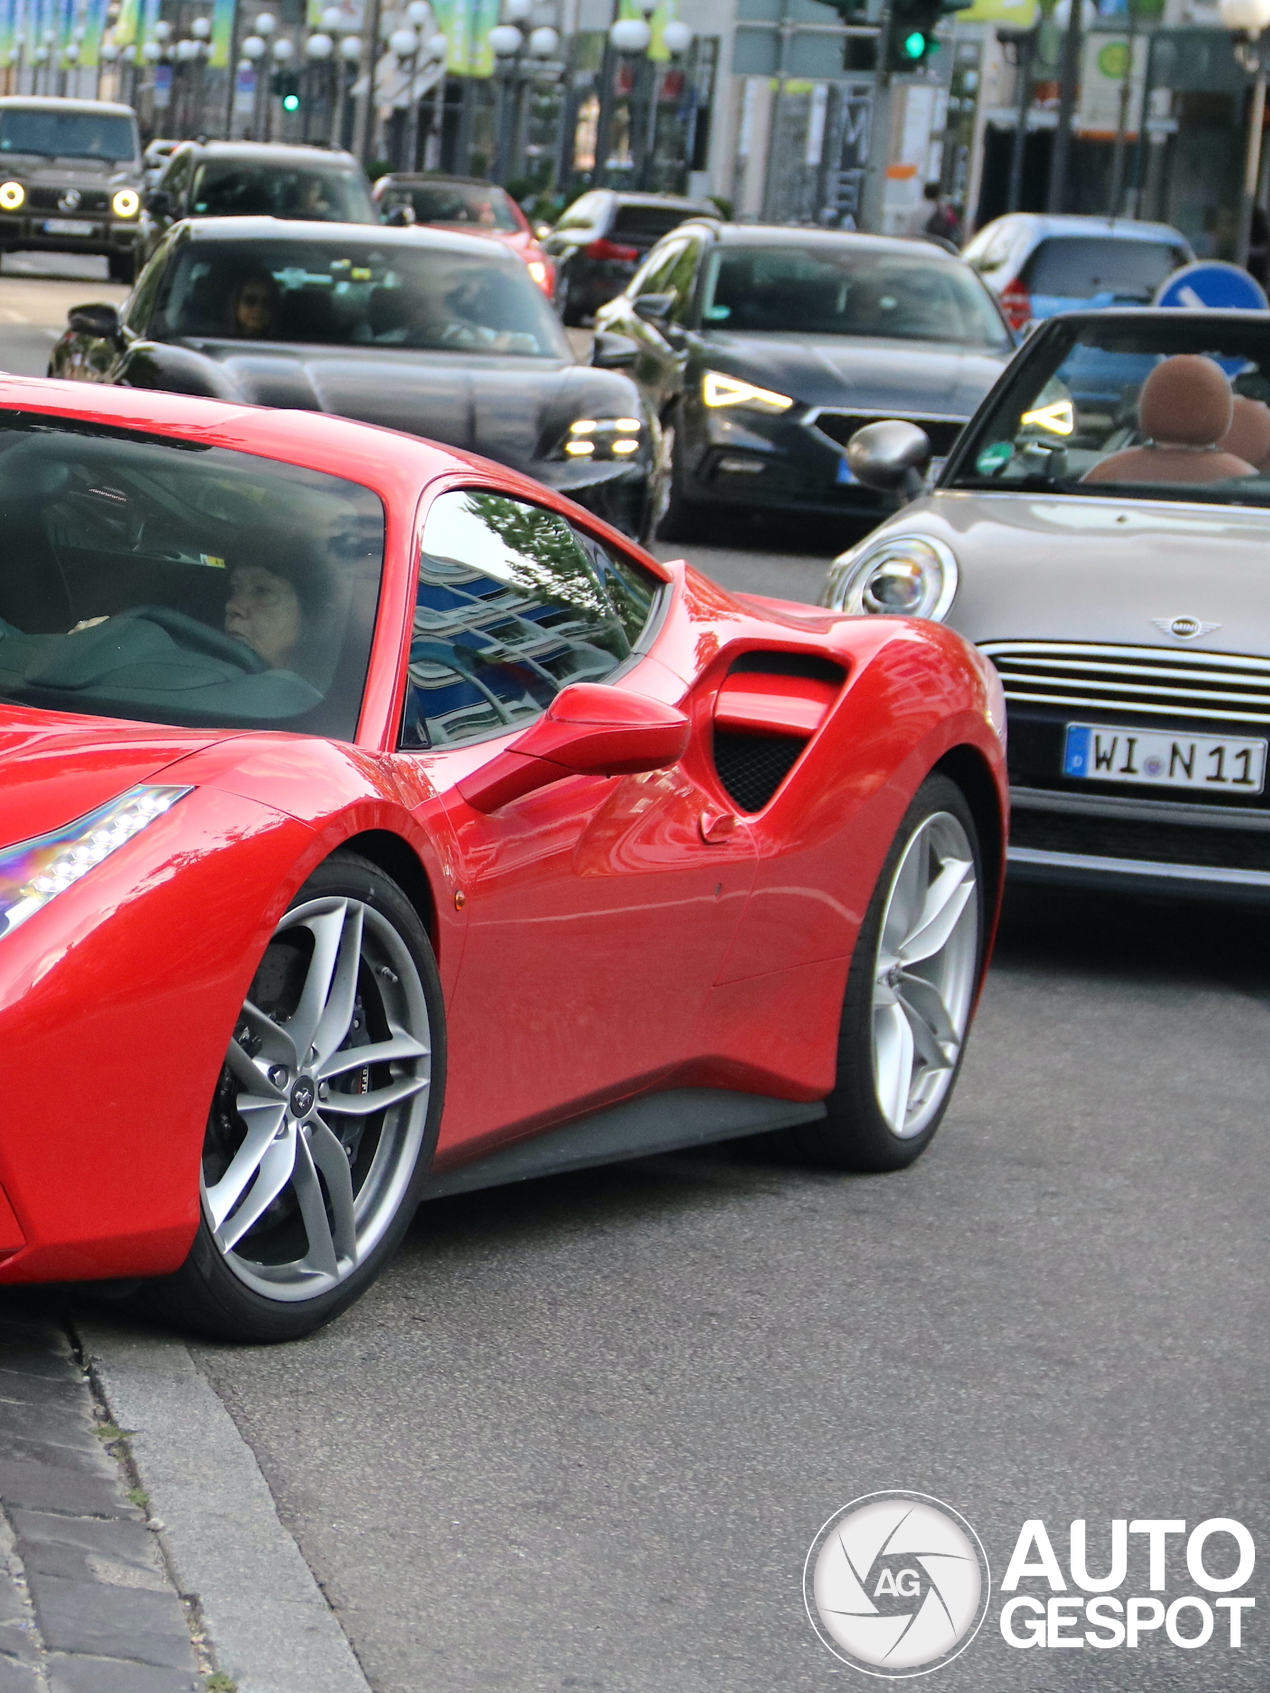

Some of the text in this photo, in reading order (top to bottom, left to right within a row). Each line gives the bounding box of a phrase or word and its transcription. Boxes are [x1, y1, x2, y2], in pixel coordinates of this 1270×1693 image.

[1173, 622, 1199, 632] MINI
[1094, 734, 1139, 775] WI
[1169, 742, 1196, 780] N
[1205, 745, 1255, 785] 11
